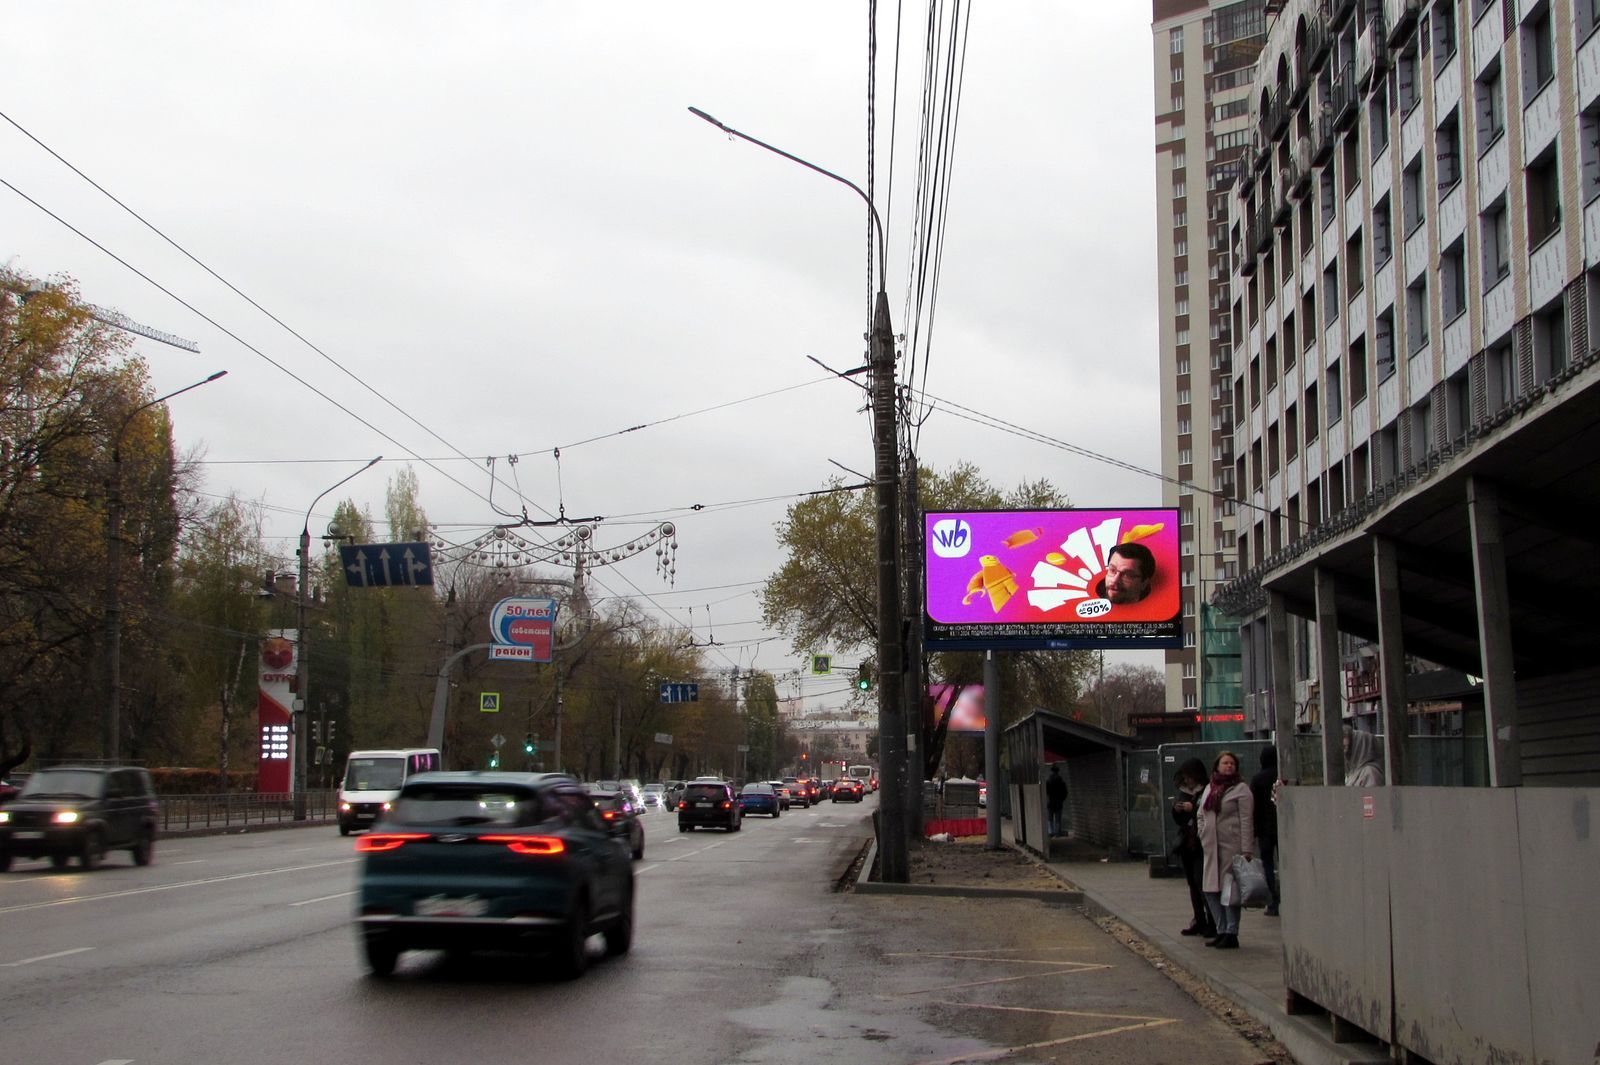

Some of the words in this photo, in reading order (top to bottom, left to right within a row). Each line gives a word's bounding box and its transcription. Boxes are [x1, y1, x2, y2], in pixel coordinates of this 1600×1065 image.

[506, 605, 523, 616] 50
[527, 608, 551, 616] лет
[495, 647, 530, 657] район
